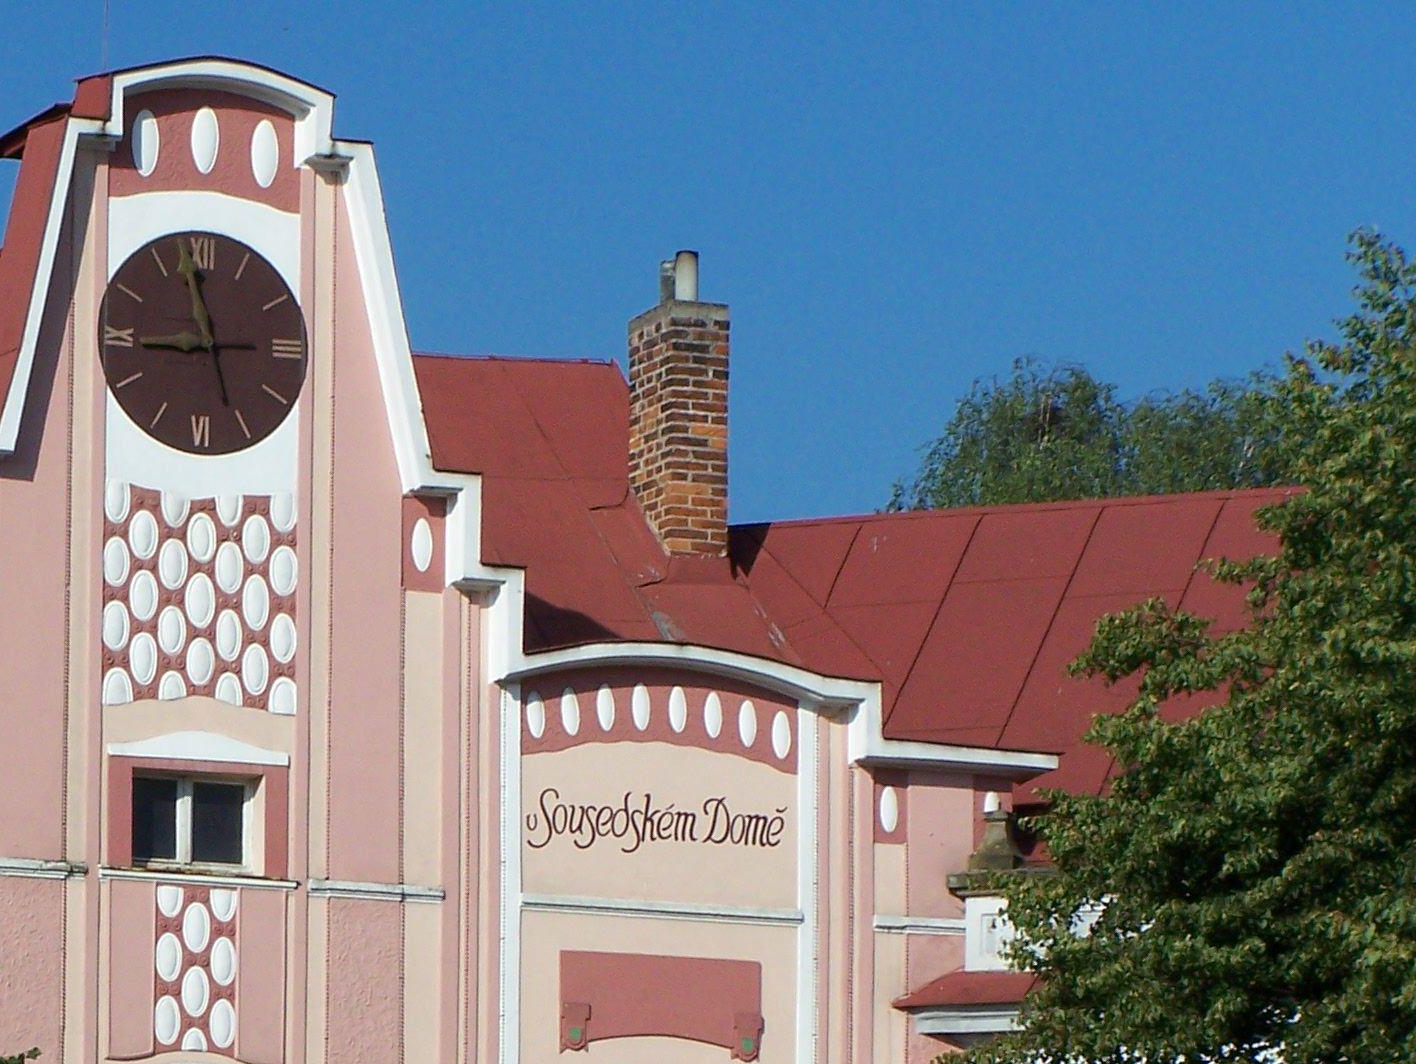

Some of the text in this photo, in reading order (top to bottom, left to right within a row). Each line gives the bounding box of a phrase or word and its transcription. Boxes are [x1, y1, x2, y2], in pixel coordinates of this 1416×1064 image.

[271, 338, 302, 359] III
[191, 415, 210, 447] VI
[527, 788, 697, 853] Sousedském
[702, 796, 788, 847] Domě
